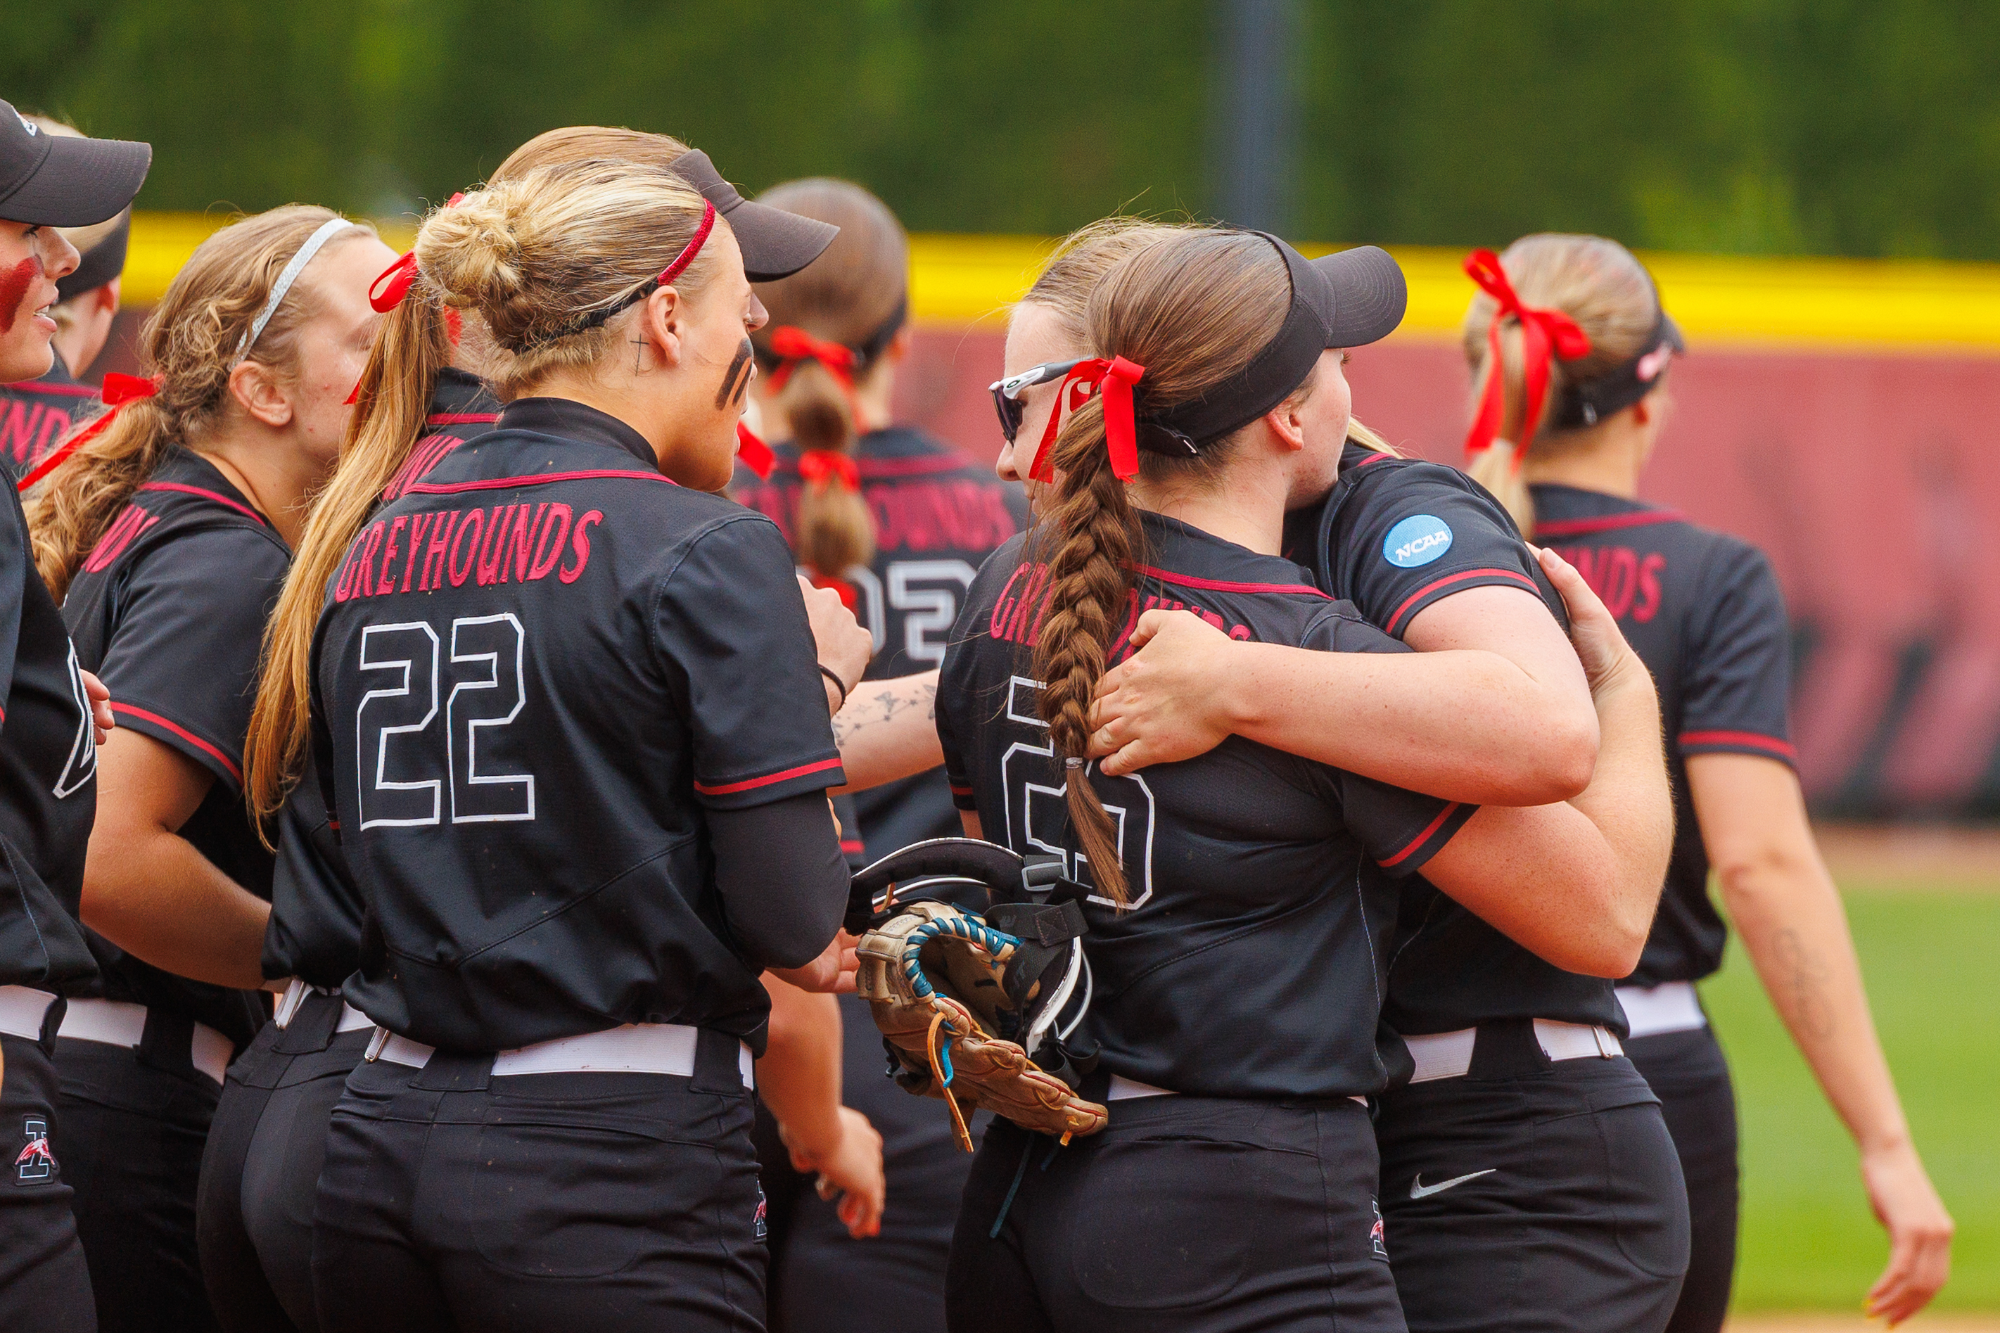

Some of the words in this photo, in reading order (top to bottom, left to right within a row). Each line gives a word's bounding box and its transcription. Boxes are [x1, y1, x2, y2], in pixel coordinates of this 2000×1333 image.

[335, 502, 604, 602] GREYHOUNDS
[1395, 530, 1450, 561] NCAA
[356, 612, 535, 832] 22
